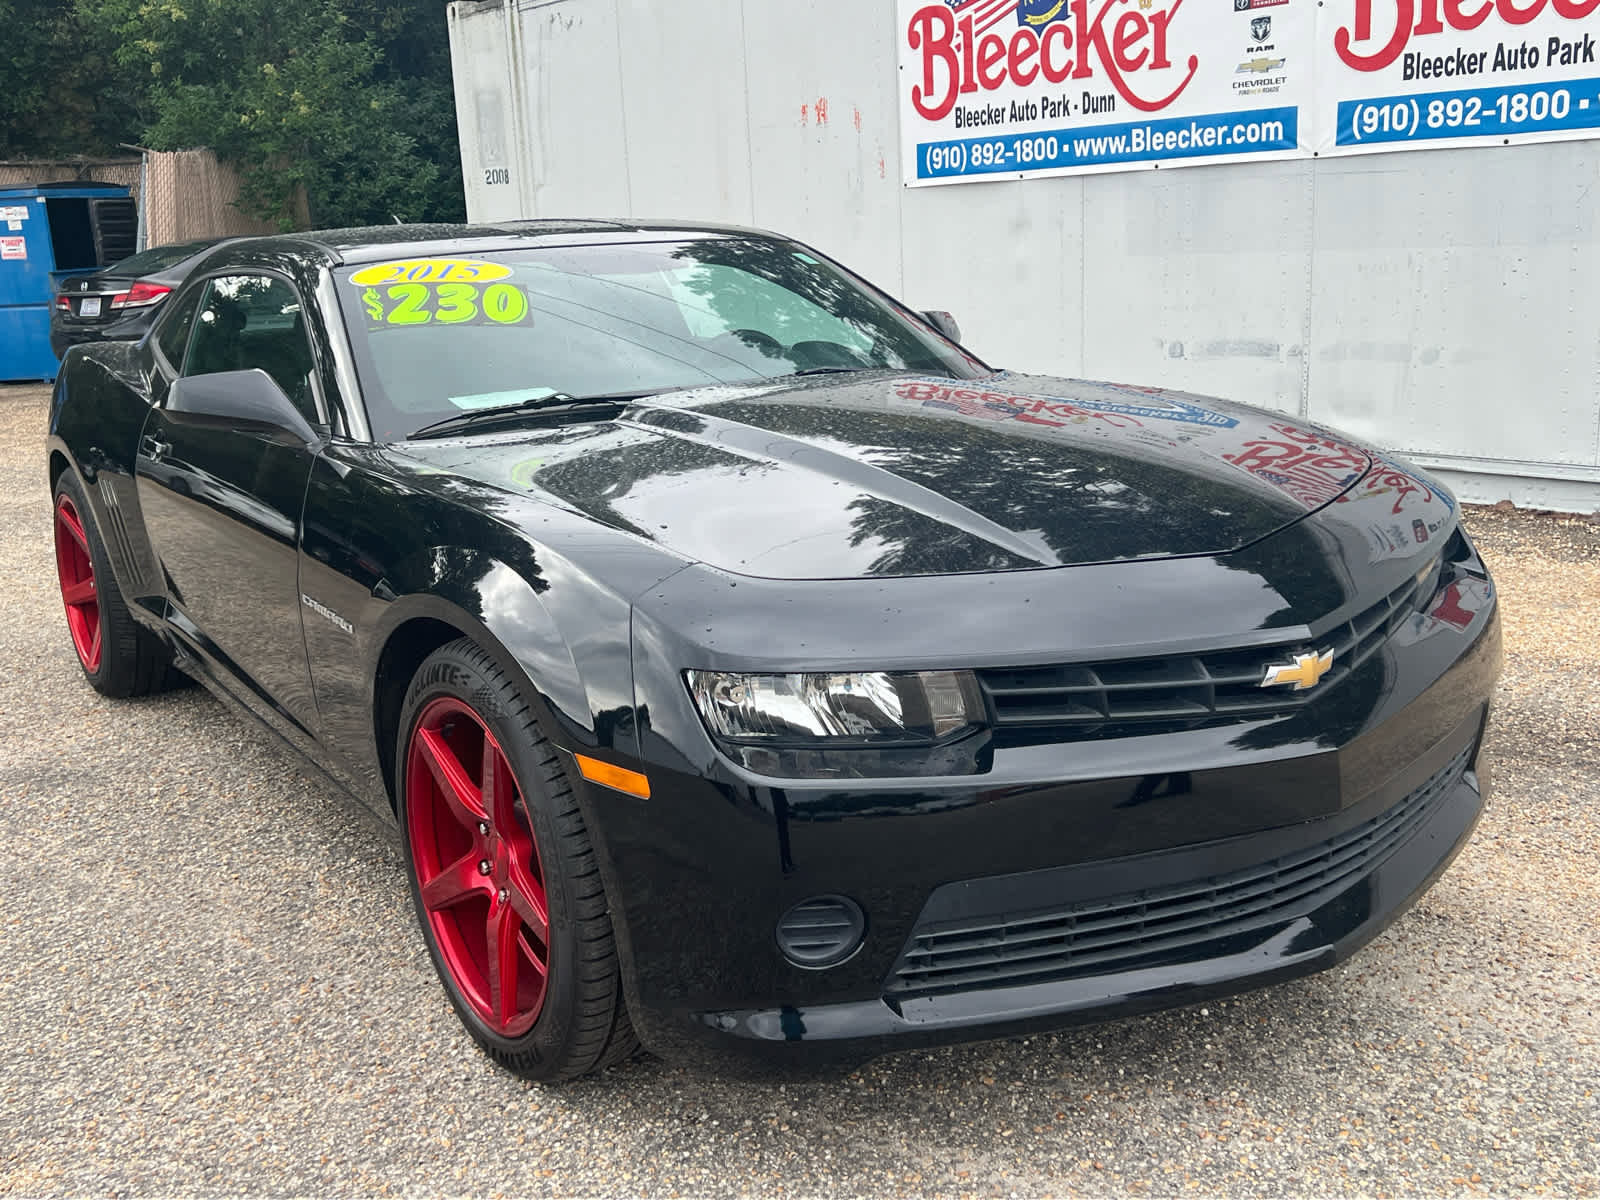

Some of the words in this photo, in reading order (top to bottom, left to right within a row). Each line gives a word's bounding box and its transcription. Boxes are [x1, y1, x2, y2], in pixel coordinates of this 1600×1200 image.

[908, 0, 1198, 121] Bleecker
[1246, 44, 1275, 53] RAM
[1402, 47, 1488, 81] Bleecker
[1491, 41, 1540, 72] Auto
[1546, 33, 1596, 67] Park
[1232, 76, 1288, 89] CHEVROLET
[955, 103, 1006, 129] Bleecker
[1009, 100, 1038, 123] Auto
[1041, 94, 1071, 119] Park
[1082, 91, 1116, 115] Dunn
[1351, 99, 1420, 140] (910)
[1427, 89, 1571, 128] 892-1800
[926, 142, 967, 174] (910)
[972, 136, 1058, 167] 892-1800
[1074, 120, 1284, 157] www.Bleecker.com
[484, 168, 510, 185] 2008
[383, 263, 486, 283] 2015
[362, 283, 529, 326] $230
